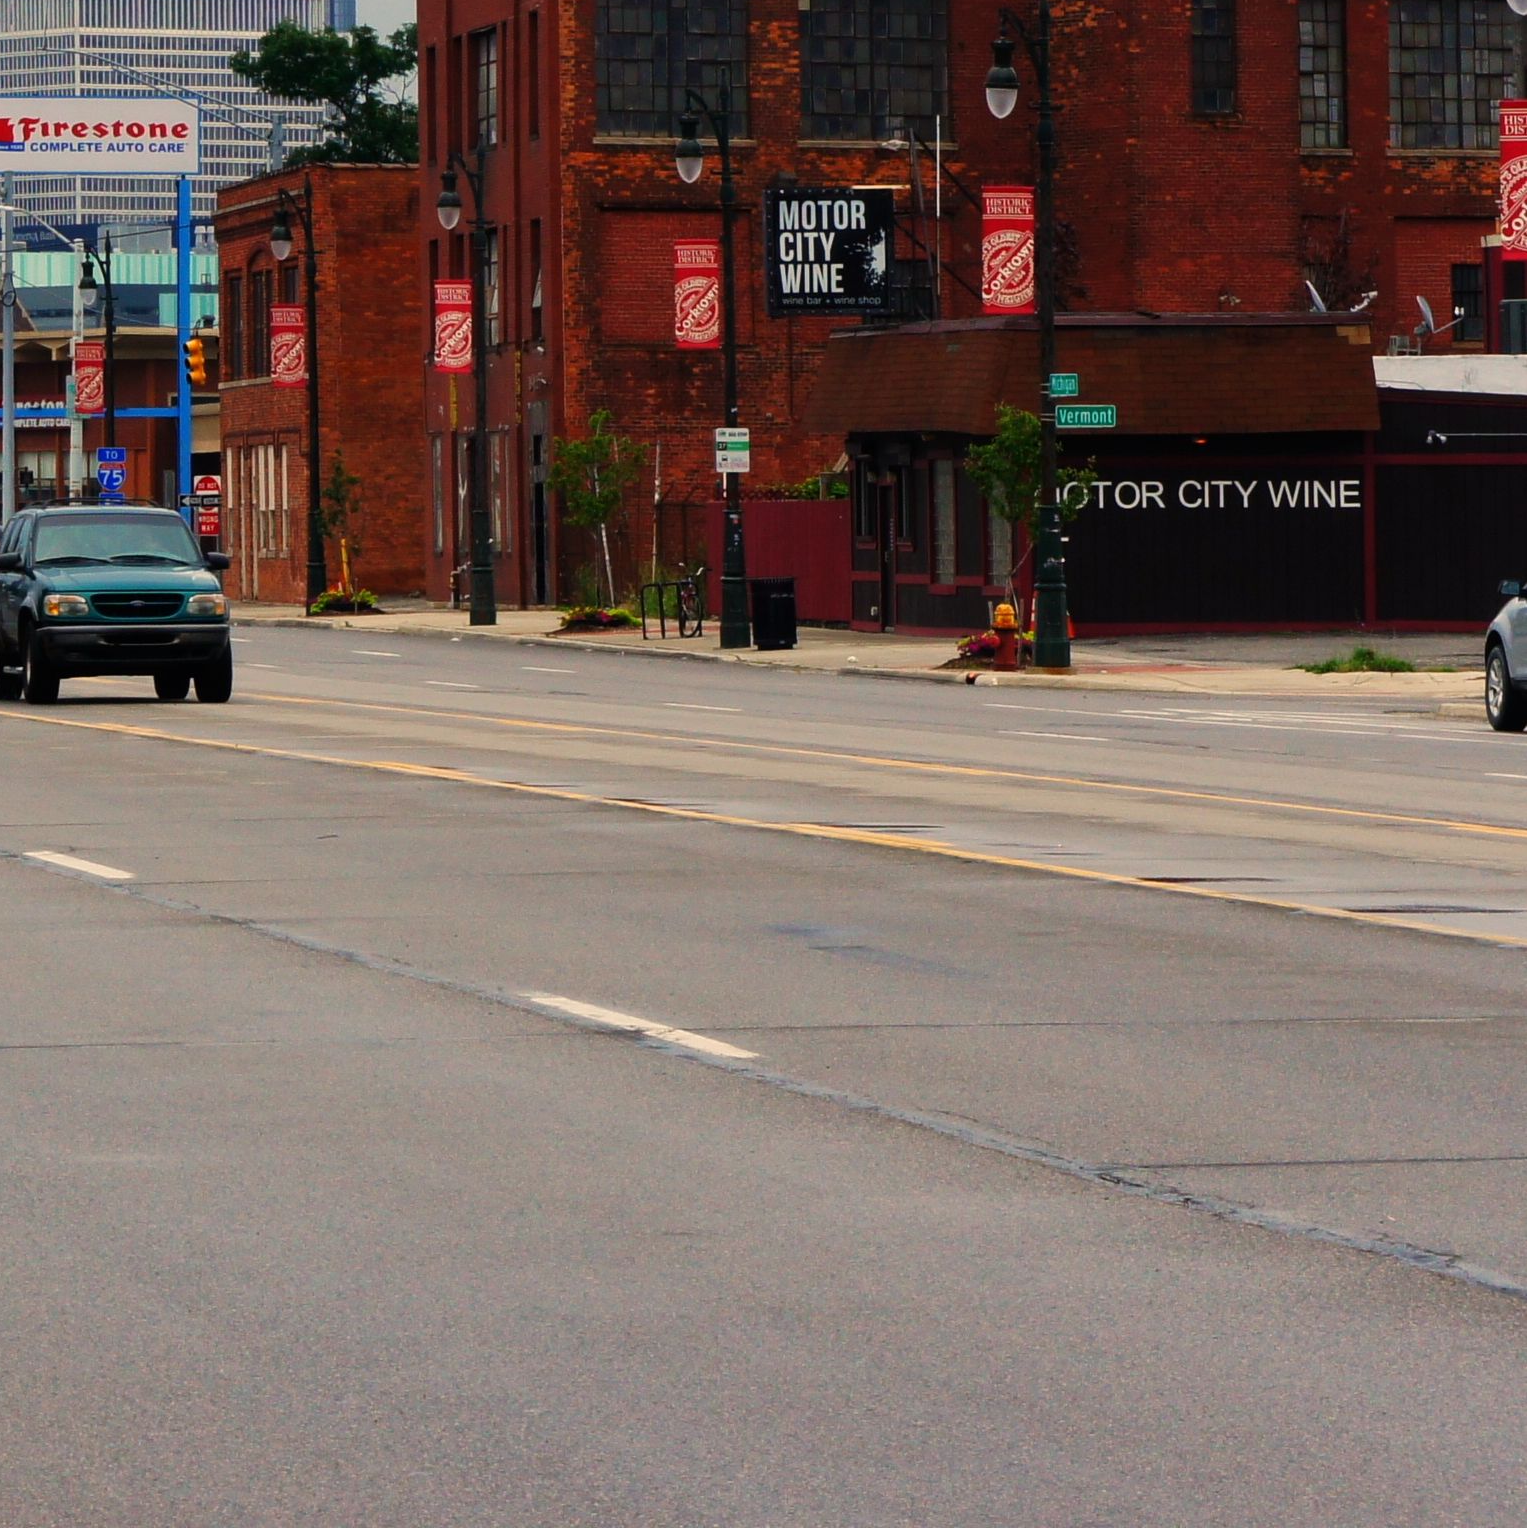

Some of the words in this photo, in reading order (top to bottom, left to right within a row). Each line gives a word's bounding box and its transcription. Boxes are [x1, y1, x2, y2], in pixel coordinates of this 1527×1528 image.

[18, 117, 189, 142] Firestone
[30, 142, 102, 152] COMPLETE
[106, 142, 144, 152] AUTO
[149, 142, 184, 152] CARE
[986, 198, 1031, 207] HISTORIC
[987, 206, 1031, 214] DISTRICT
[779, 200, 866, 230] MOTOR
[779, 232, 835, 261] CITY
[779, 263, 844, 293] WINE
[982, 239, 1034, 300] Corktown
[675, 283, 719, 336] Corktown
[806, 296, 822, 304] bar
[858, 296, 881, 306] shop
[1051, 376, 1076, 394] Michigan
[1059, 408, 1112, 424] Vermont
[106, 451, 118, 459] TO
[99, 470, 123, 486] 75
[1055, 481, 1166, 509] OTOR
[1178, 480, 1258, 508] CITY
[1267, 480, 1361, 508] WINE
